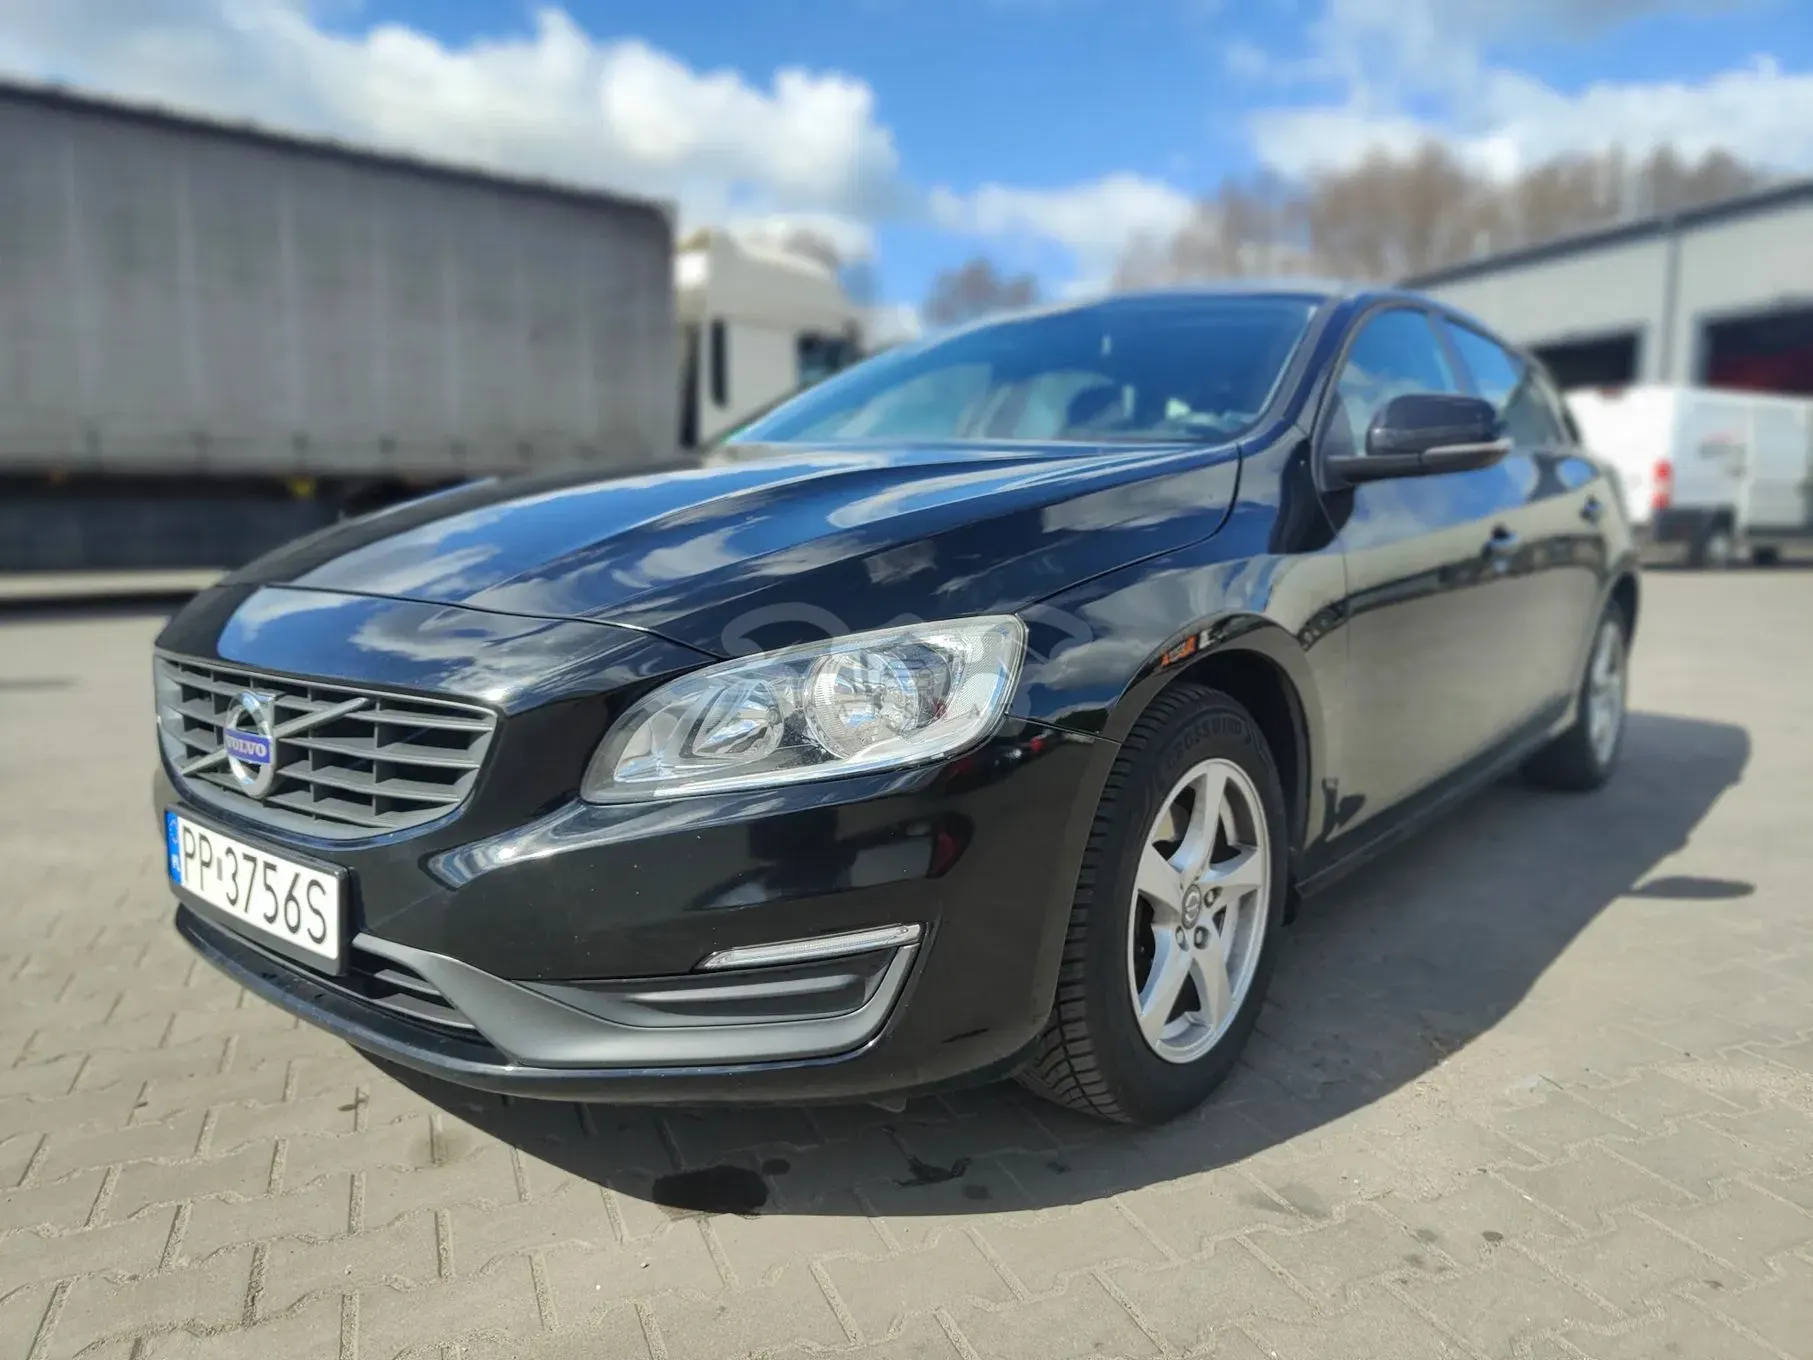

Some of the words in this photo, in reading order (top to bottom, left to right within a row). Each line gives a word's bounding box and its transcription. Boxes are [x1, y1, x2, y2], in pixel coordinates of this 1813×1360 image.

[226, 735, 267, 758] VOLVO
[183, 825, 213, 891] PP
[225, 847, 327, 944] 3756S
